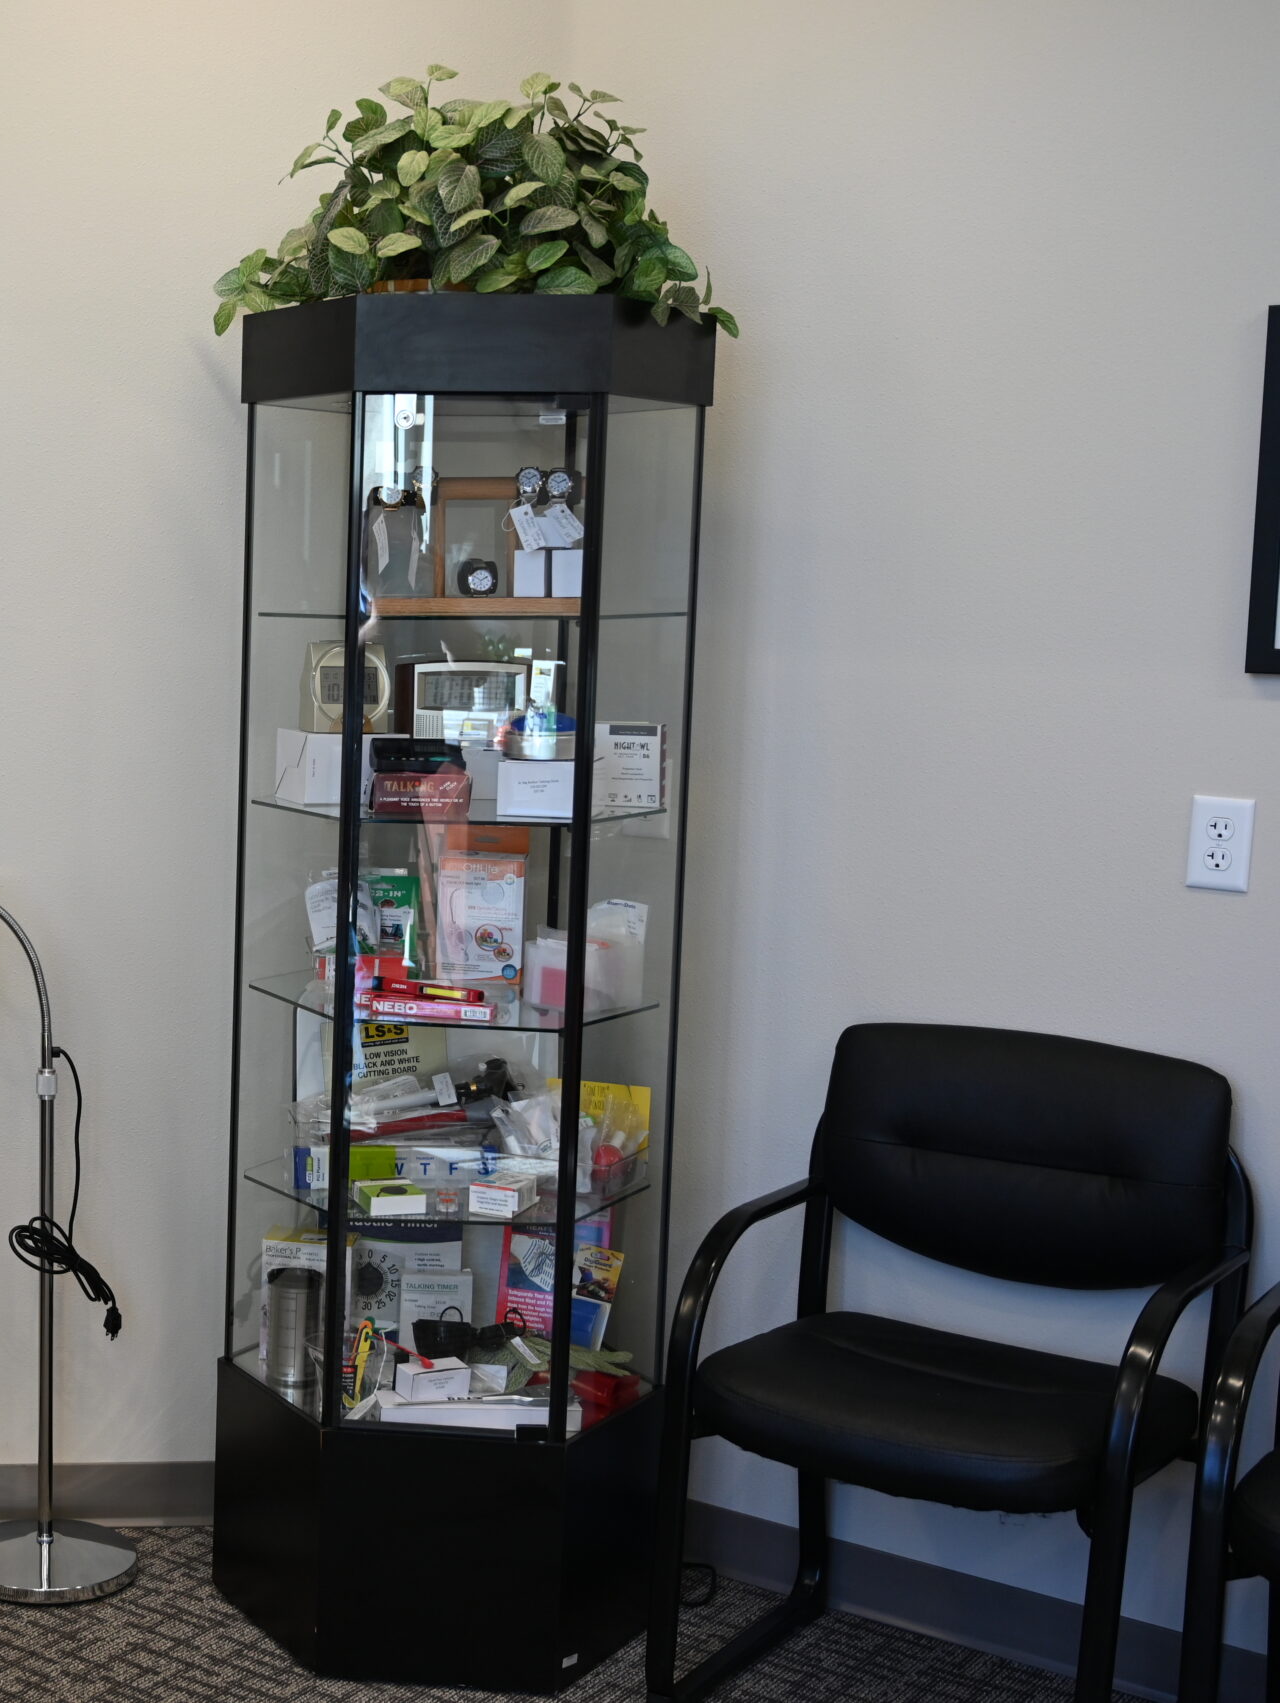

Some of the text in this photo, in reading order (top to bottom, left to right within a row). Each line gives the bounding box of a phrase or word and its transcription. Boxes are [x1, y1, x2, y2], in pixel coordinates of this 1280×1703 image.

[372, 1000, 418, 1014] NEBO
[364, 1025, 406, 1040] LS&S
[364, 1048, 409, 1061] LOW VISION
[353, 1055, 421, 1071] BLACK AND WHITE
[357, 1065, 418, 1079] CUTTING BOARD
[420, 1162, 431, 1176] T
[448, 1162, 459, 1176] F
[367, 1248, 374, 1259] 0
[379, 1254, 388, 1264] 5
[387, 1263, 399, 1275] 10
[390, 1279, 401, 1288] 15
[406, 1282, 459, 1291] TALKING TIMER
[385, 1290, 397, 1302] 20
[361, 1301, 372, 1311] 30
[375, 1299, 386, 1310] 25
